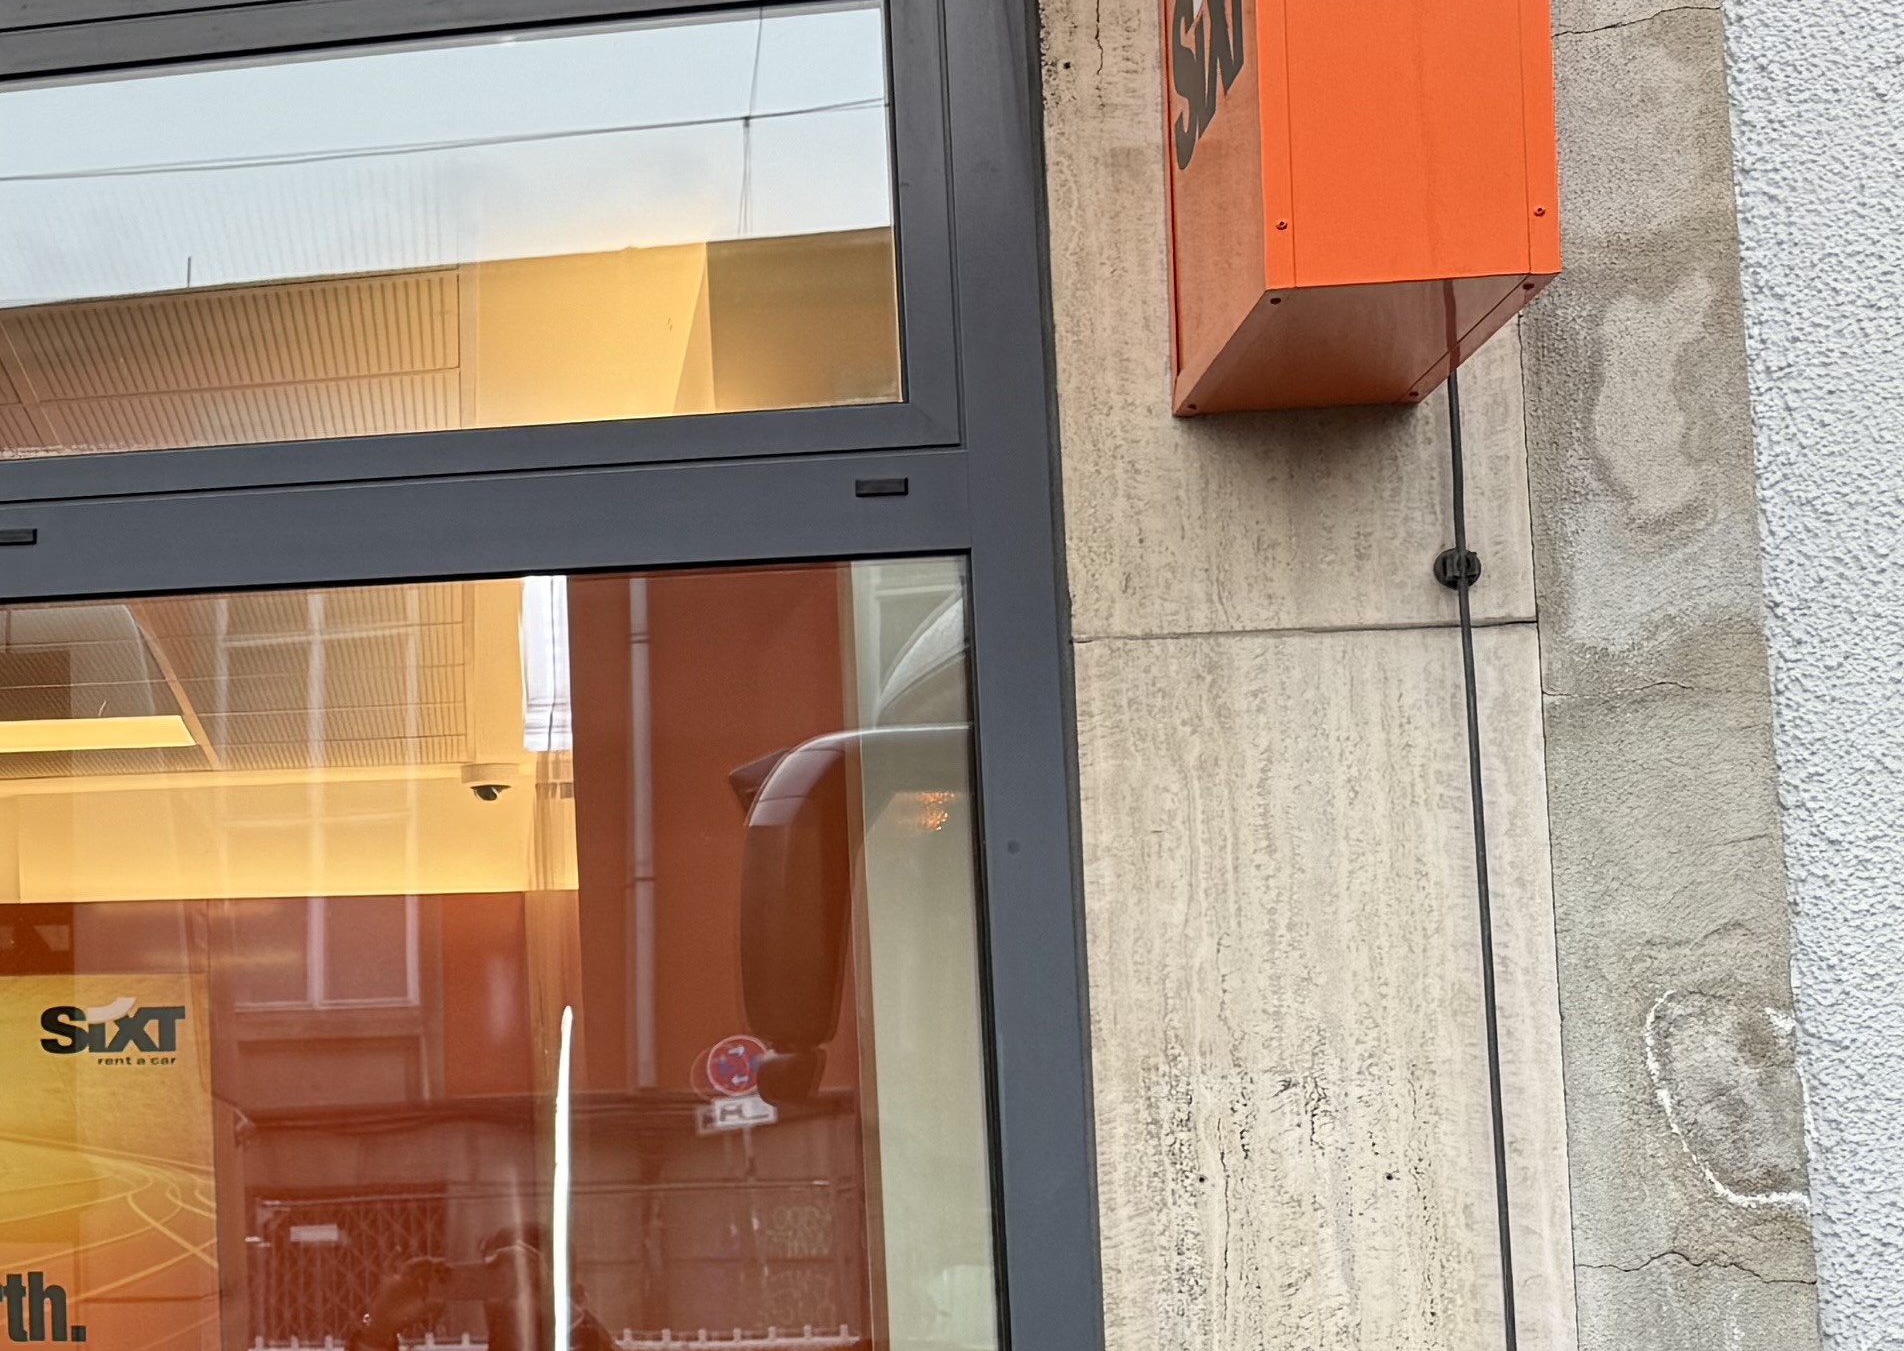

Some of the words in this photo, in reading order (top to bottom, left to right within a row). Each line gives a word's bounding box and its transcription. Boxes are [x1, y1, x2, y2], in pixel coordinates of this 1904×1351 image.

[97, 1055, 132, 1066] rent
[136, 1057, 146, 1065] a
[149, 1056, 176, 1066] car
